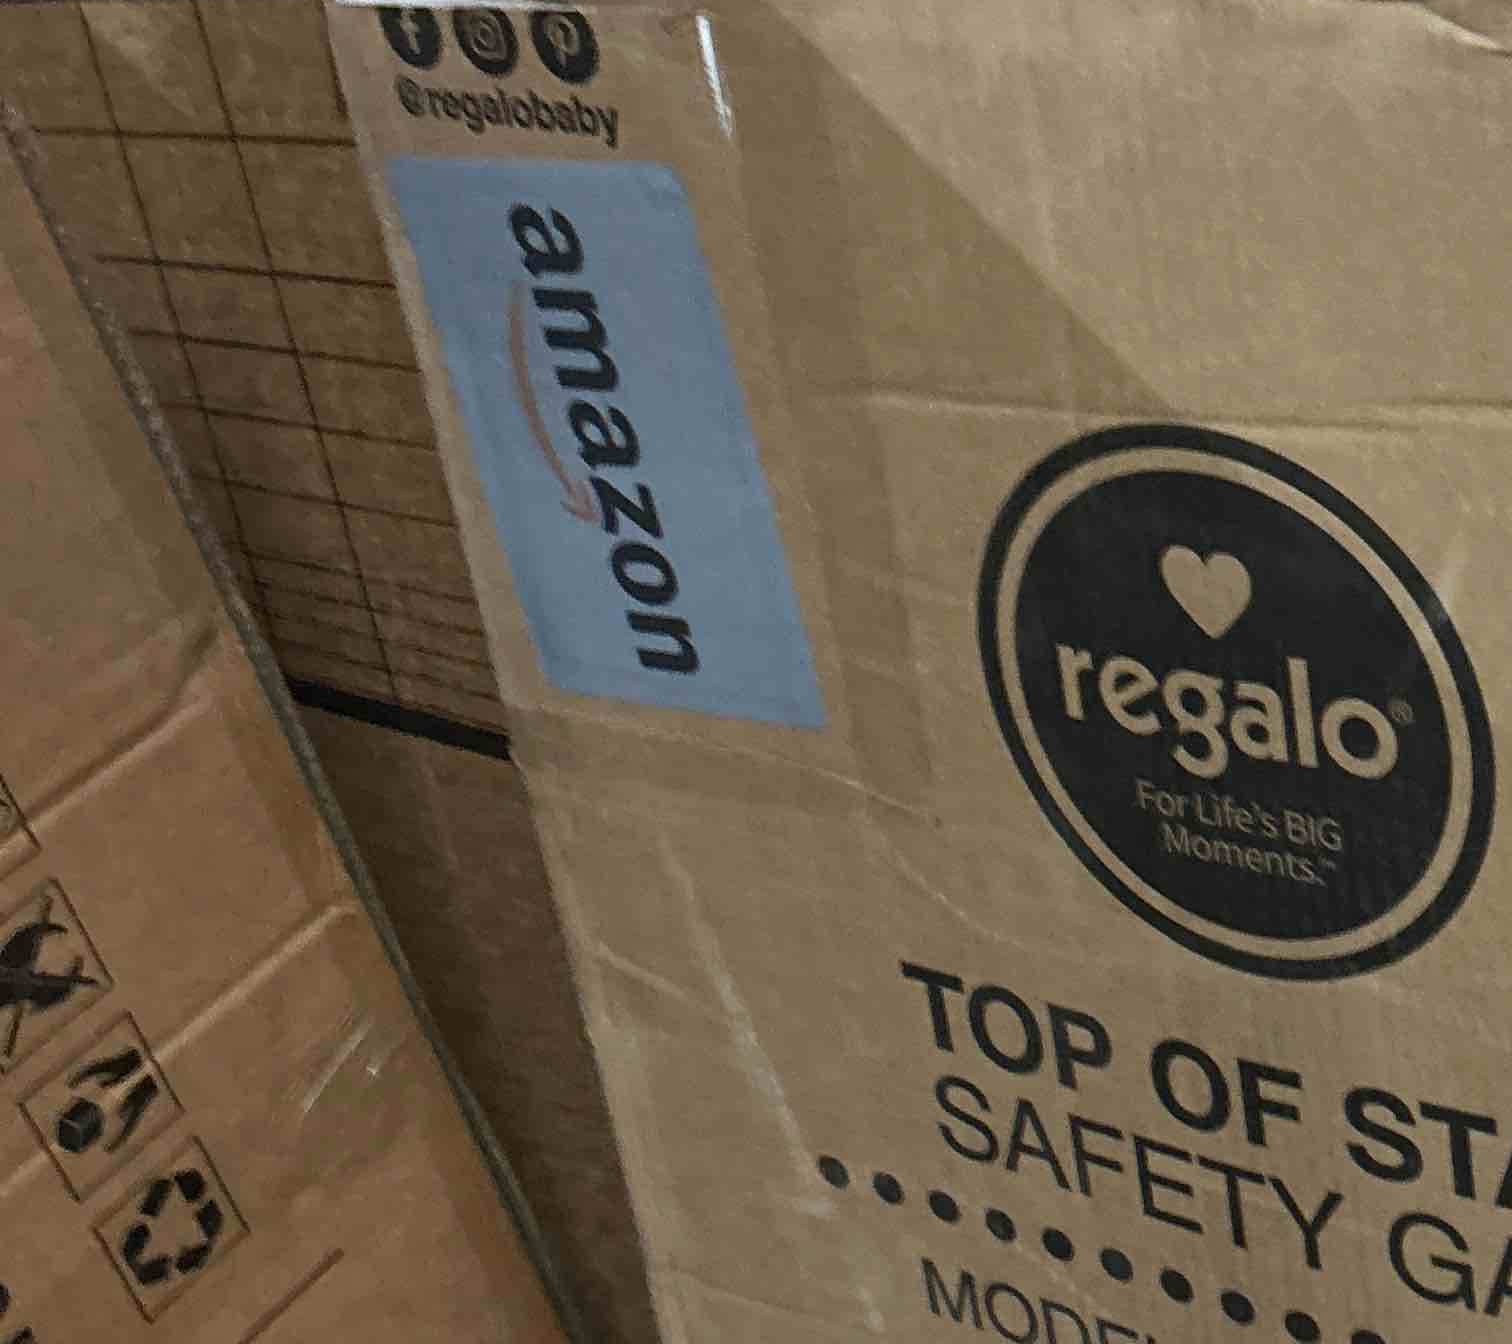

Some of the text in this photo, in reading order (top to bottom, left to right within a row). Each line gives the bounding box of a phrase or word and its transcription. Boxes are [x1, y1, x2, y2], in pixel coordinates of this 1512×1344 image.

[396, 74, 618, 148] @regalobaby
[507, 202, 698, 675] amazon
[1055, 642, 1399, 780] regalo
[1136, 777, 1342, 851] For Life's BIG
[900, 961, 1112, 1089] TOP
[1150, 1039, 1302, 1147] OF
[935, 1076, 1343, 1270] SAFETY
